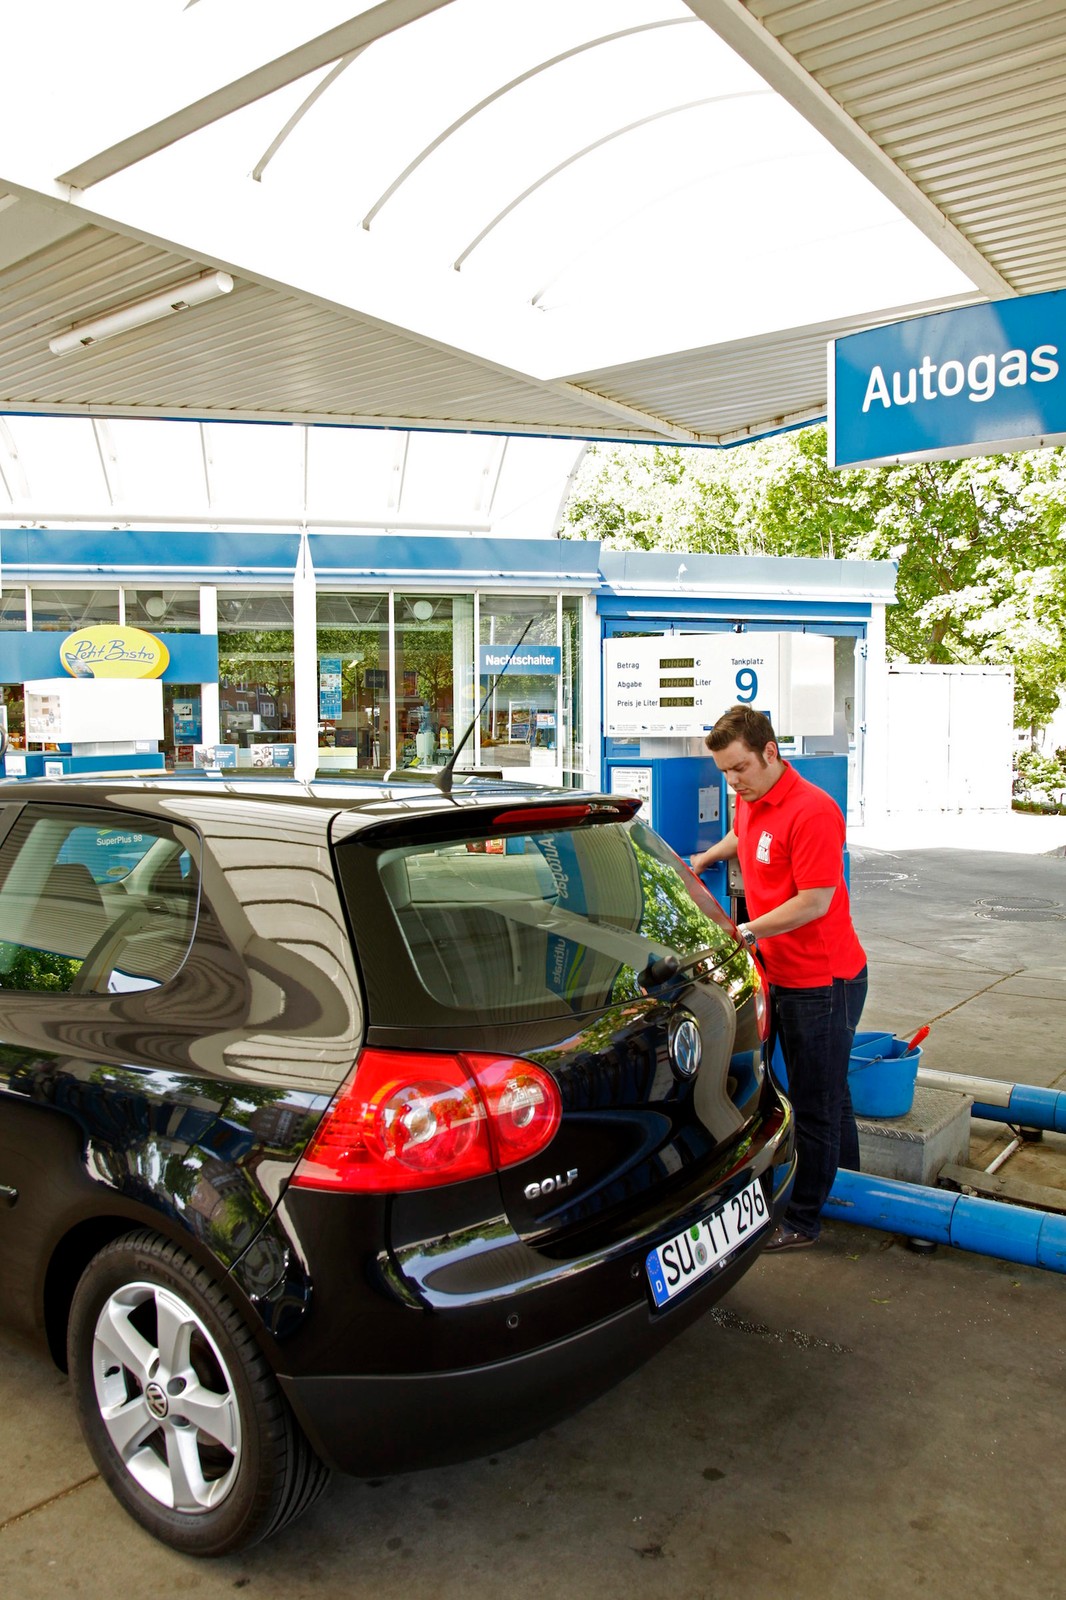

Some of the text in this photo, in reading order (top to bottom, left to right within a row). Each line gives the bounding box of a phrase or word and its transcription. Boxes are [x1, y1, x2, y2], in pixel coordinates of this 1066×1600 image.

[861, 344, 1060, 413] Autogas
[74, 639, 155, 660] Petit Bistro
[485, 654, 556, 666] Nachtschalter
[695, 659, 702, 667] €
[731, 658, 764, 666] Tankplatz
[617, 681, 642, 689] Abgabe
[735, 667, 759, 703] 9
[617, 699, 634, 707] Preis
[635, 699, 642, 708] je
[643, 699, 658, 707] Liter
[695, 698, 703, 706] ct
[96, 834, 143, 846] SuperPlus 98
[523, 1168, 579, 1200] GOLF
[661, 1182, 765, 1287] SU TT 296
[655, 1280, 663, 1293] D
